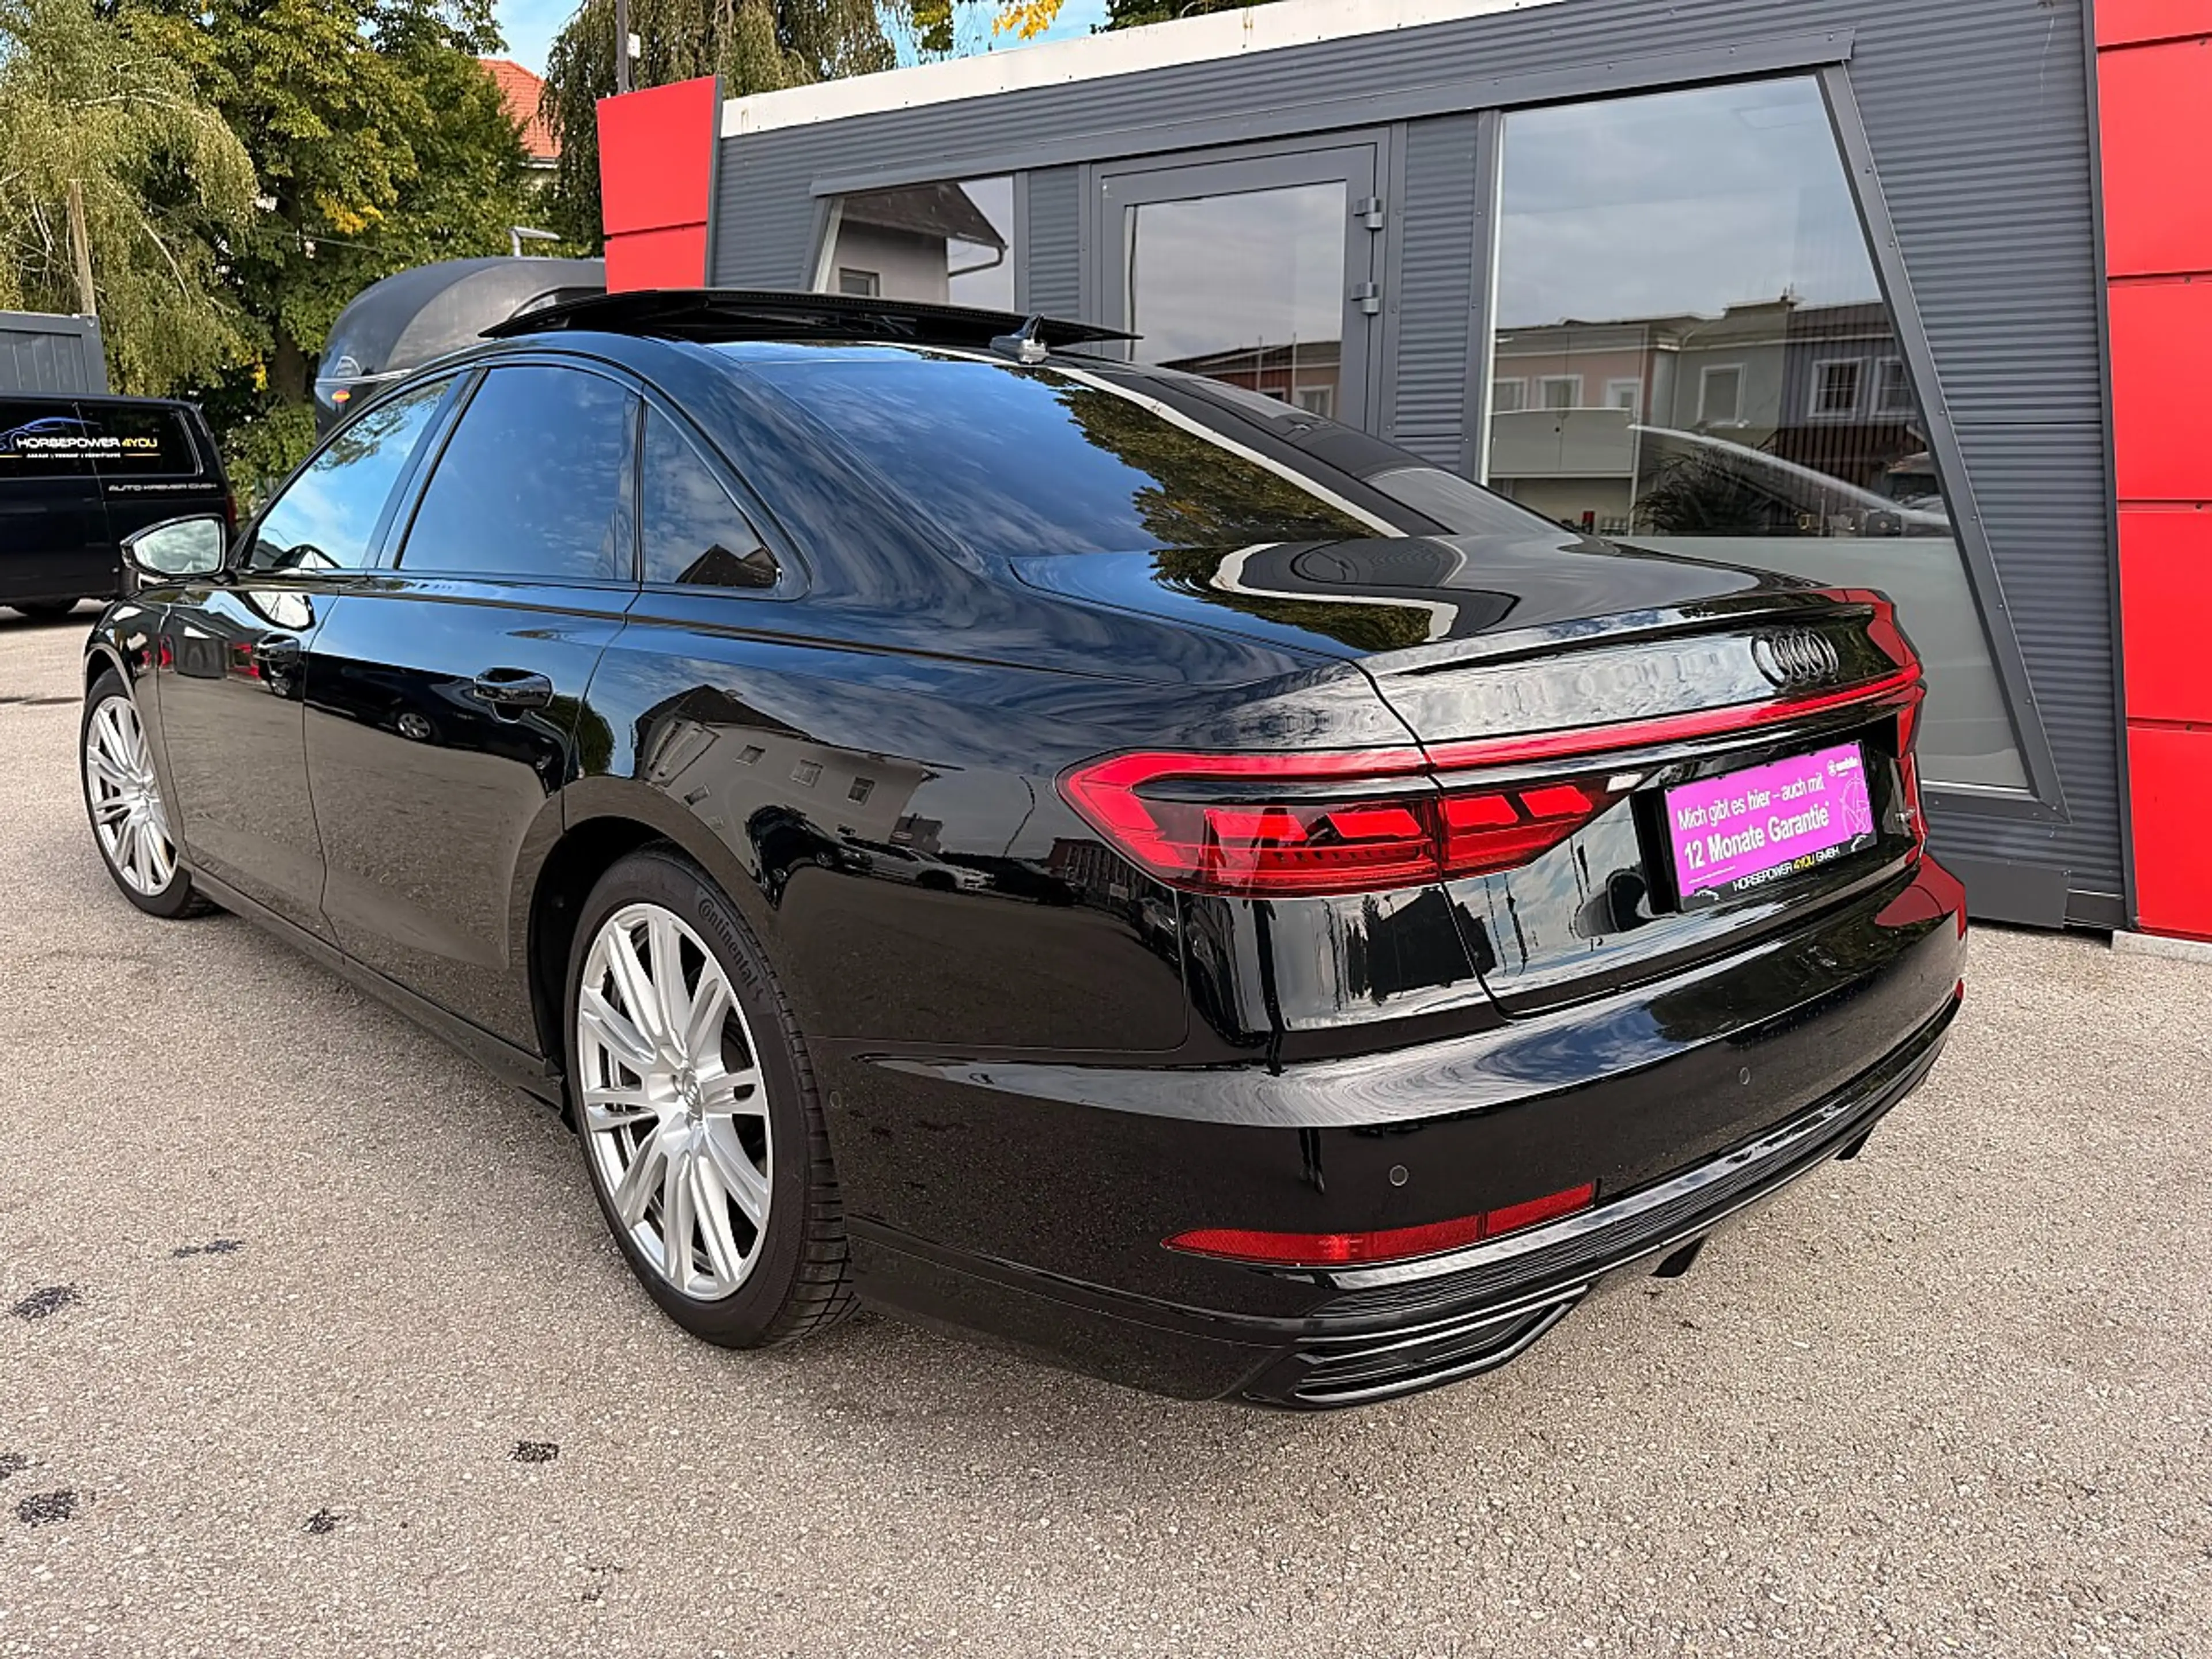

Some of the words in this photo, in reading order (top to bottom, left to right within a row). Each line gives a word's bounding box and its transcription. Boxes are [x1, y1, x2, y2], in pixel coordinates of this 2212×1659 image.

[16, 437, 120, 449] HORSEPOWER
[122, 437, 158, 448] 4YOU
[1677, 804, 1708, 831] Mich
[1709, 798, 1730, 827] gibt
[1731, 798, 1747, 816] es
[1747, 789, 1771, 811] hier
[1781, 777, 1808, 801] auch
[1808, 772, 1825, 794] mit
[1684, 840, 1706, 870] 12
[1707, 823, 1766, 863] Monate
[1732, 862, 1793, 892] HORSEPOWER
[1793, 854, 1815, 869] 4YOU
[698, 897, 759, 989] Continental
